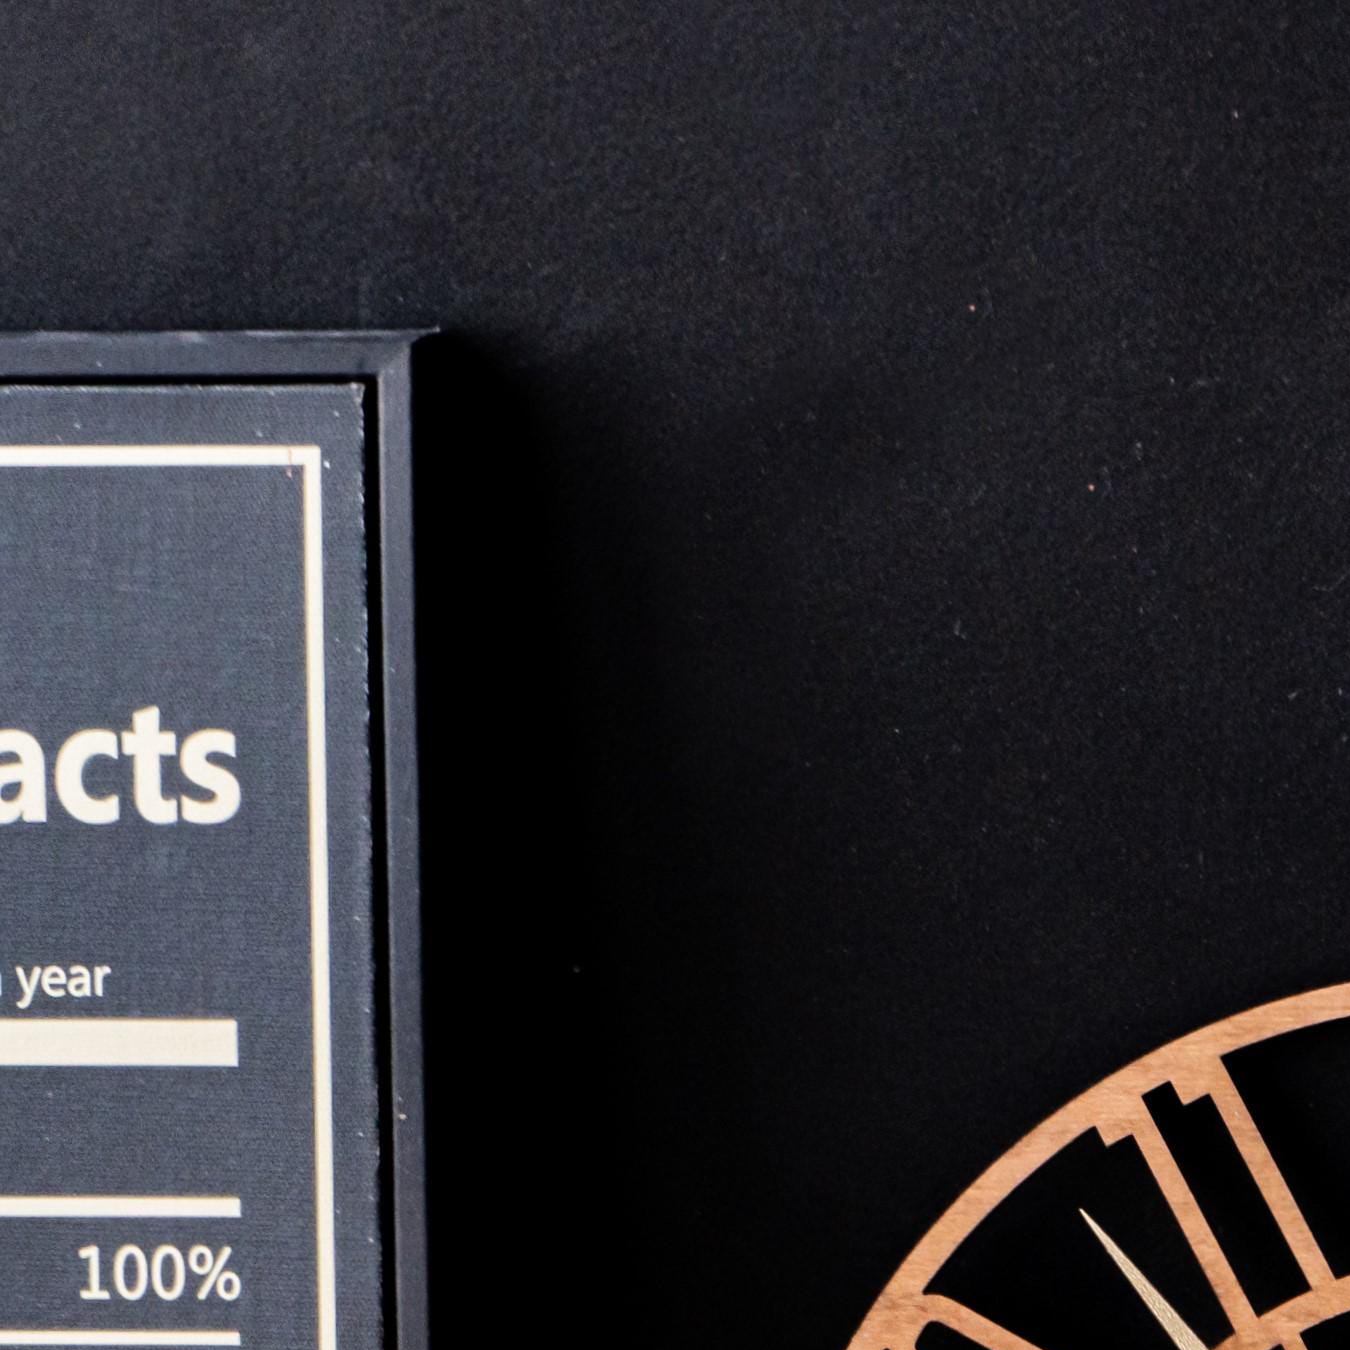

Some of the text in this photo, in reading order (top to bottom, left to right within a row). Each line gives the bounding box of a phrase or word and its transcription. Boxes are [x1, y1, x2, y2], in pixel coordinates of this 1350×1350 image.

[0, 705, 242, 825] acts
[15, 964, 112, 1010] year
[1092, 1050, 1337, 1337] 11
[78, 1243, 242, 1302] 100%
